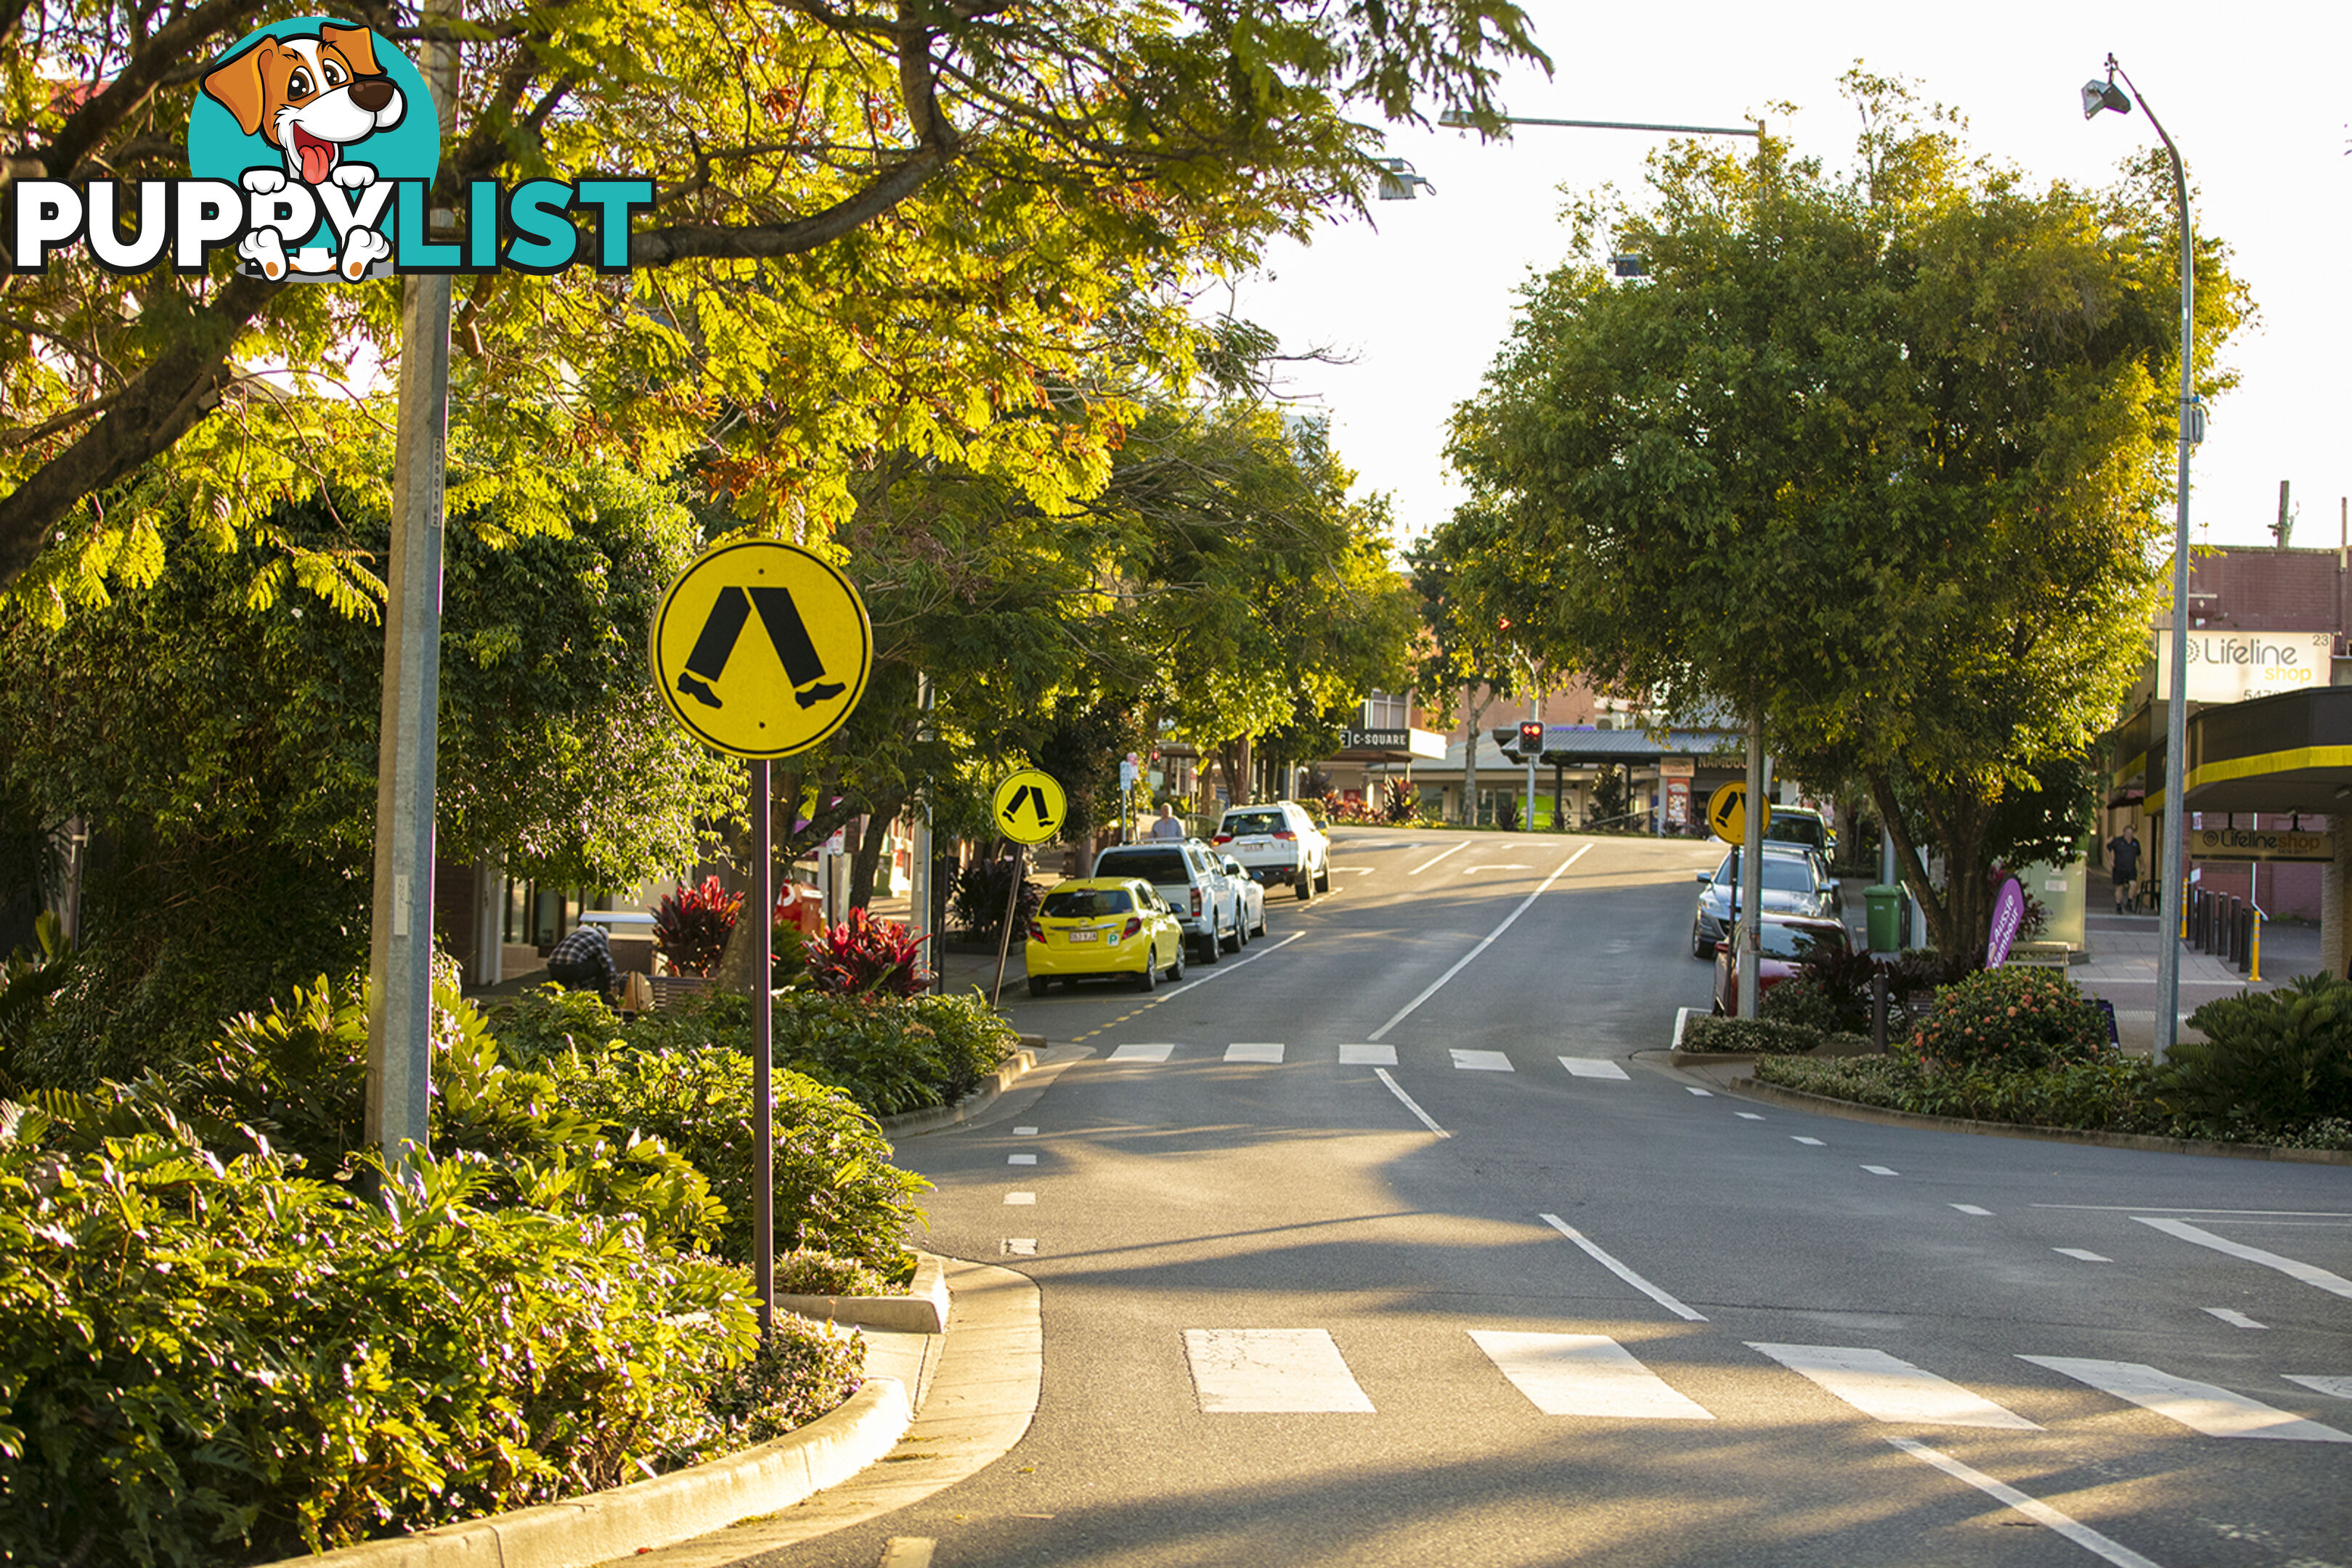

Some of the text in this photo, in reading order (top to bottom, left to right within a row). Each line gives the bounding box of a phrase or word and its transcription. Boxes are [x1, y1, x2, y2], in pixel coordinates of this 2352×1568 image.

[2311, 634, 2329, 647] 23
[2205, 637, 2298, 665] Lifeline
[2264, 664, 2312, 684] shop
[1994, 894, 2014, 943] Aussie
[1108, 934, 1118, 945] P
